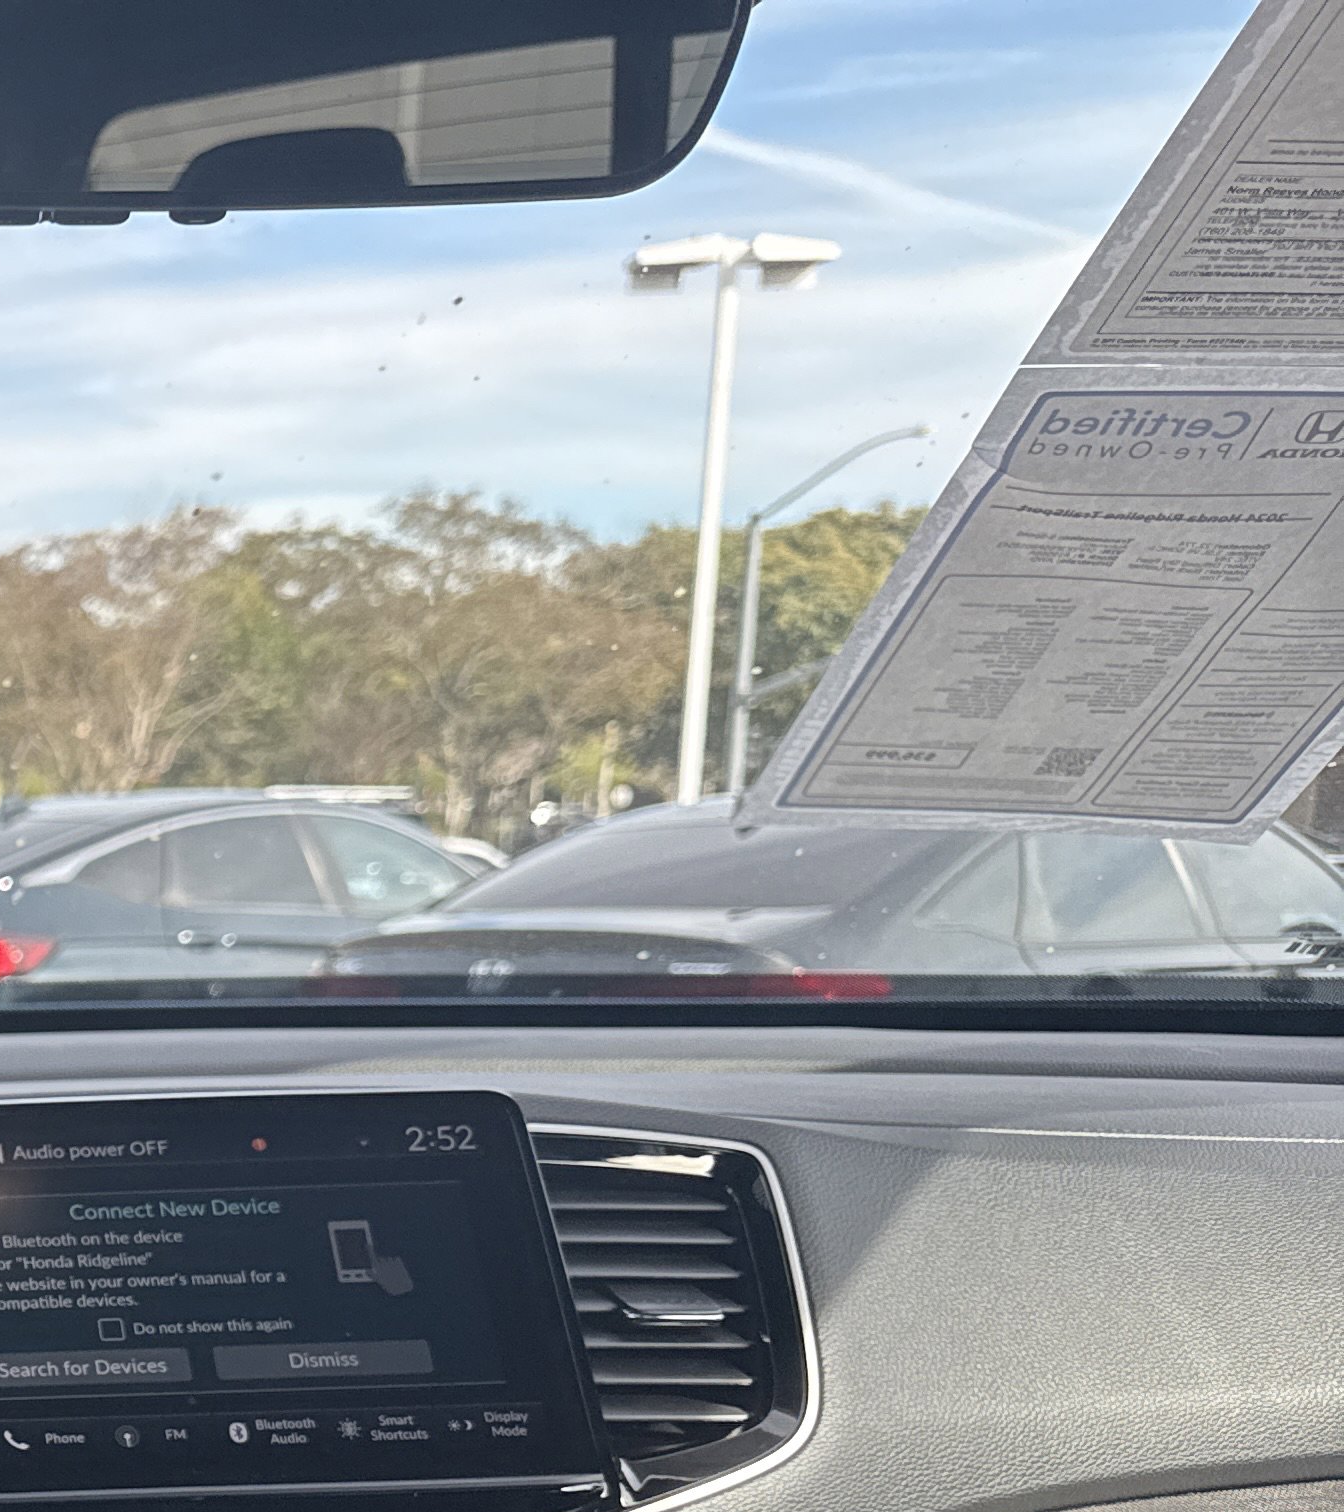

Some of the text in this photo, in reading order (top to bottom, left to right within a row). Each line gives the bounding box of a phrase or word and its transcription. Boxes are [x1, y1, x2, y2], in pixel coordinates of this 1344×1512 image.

[405, 1125, 478, 1152] 2:52
[13, 1141, 169, 1161] Audio power OFF
[69, 1198, 281, 1221] Connect New Device
[1, 1233, 78, 1249] Bluetooth
[80, 1236, 101, 1247] on
[103, 1232, 129, 1246] the
[133, 1229, 183, 1245] device
[15, 1254, 73, 1270] "Honda
[76, 1252, 153, 1271] Ridgeline"
[6, 1276, 67, 1292] website
[69, 1276, 85, 1290] in
[87, 1276, 124, 1292] your
[127, 1271, 187, 1287] owner's
[191, 1269, 247, 1285] manual
[249, 1269, 272, 1284] for
[275, 1272, 287, 1283] a
[81, 1293, 139, 1309] devices.
[133, 1316, 293, 1336] Do not show this again
[62, 1360, 89, 1377] for
[95, 1359, 167, 1376] Devices
[288, 1351, 359, 1369] Dismiss
[255, 1418, 316, 1431] Bluetooth
[378, 1414, 414, 1427] Smart
[483, 1411, 529, 1428] Display
[45, 1431, 85, 1446] Phone
[165, 1428, 187, 1441] FM
[270, 1432, 307, 1445] Audio
[371, 1428, 430, 1441] Shortcuts
[491, 1424, 528, 1438] Mode
